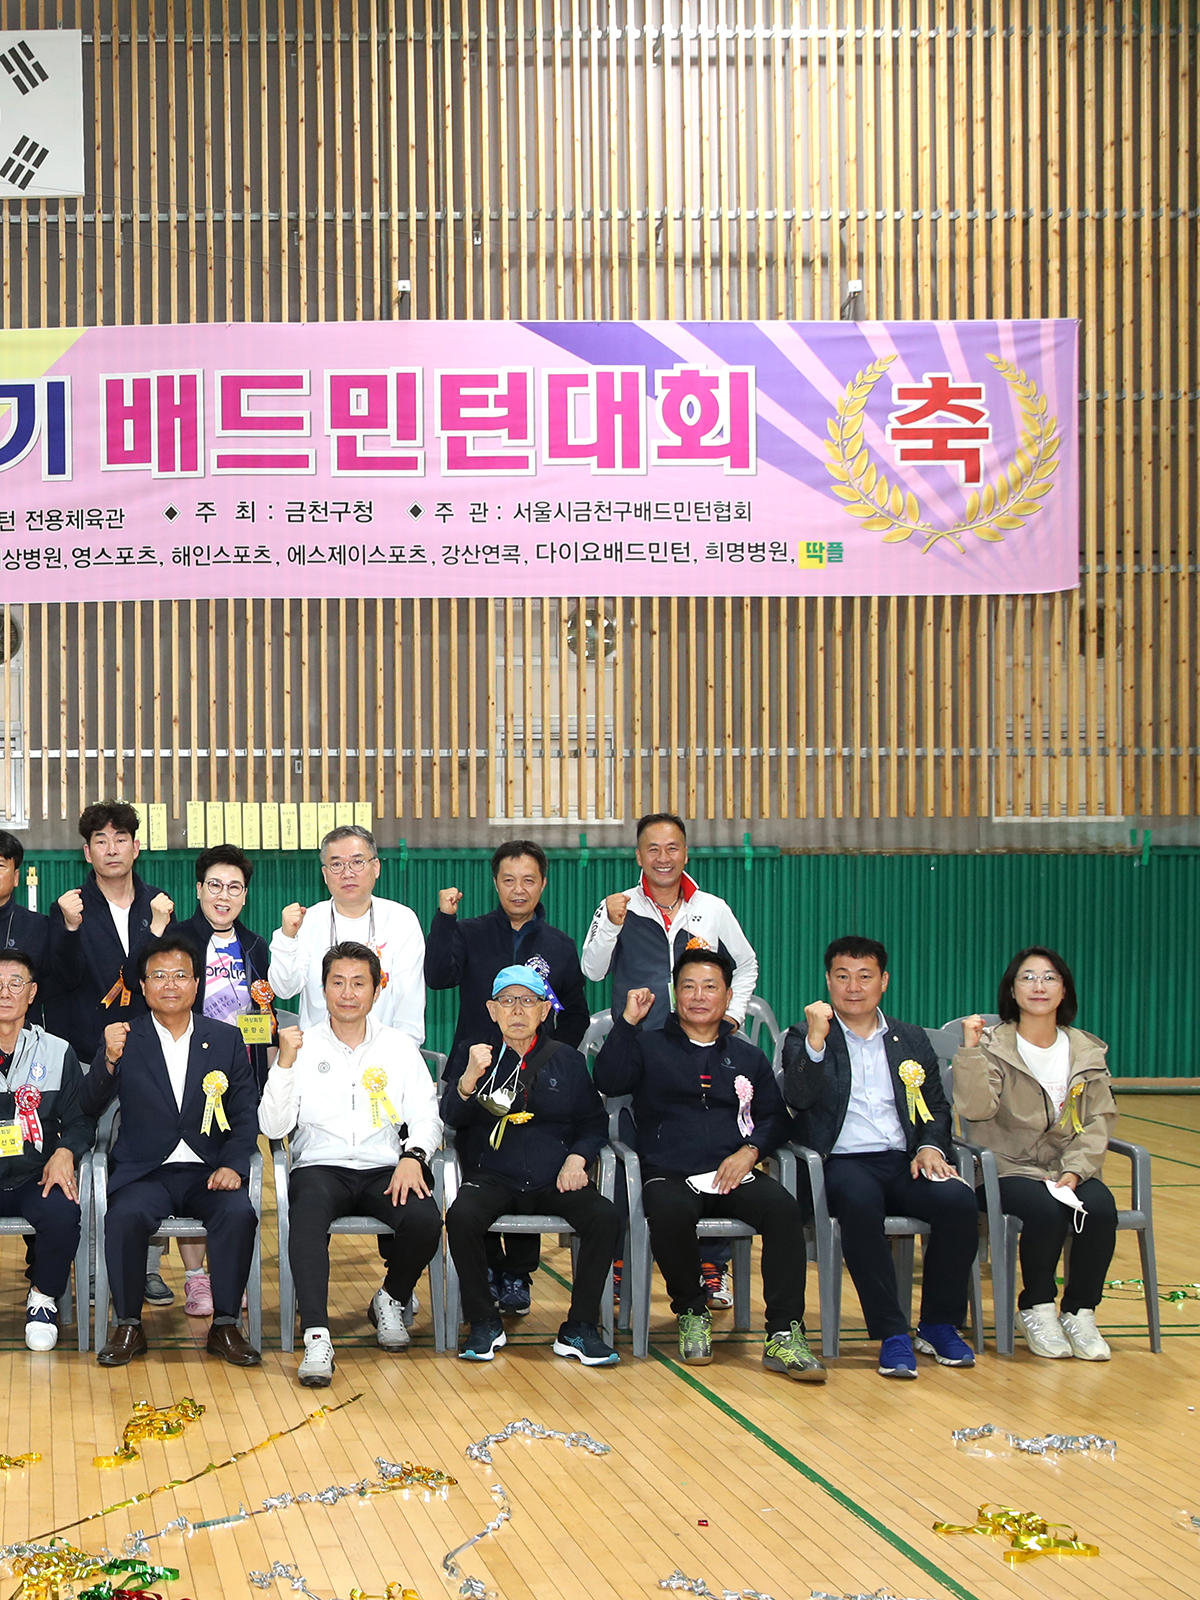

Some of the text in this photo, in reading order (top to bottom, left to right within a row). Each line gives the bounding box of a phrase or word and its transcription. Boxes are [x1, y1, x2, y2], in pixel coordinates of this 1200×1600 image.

[106, 370, 750, 473] 배드민턴대회
[891, 377, 988, 482] 축
[25, 508, 126, 532] 전용체육관
[285, 500, 373, 523] 금천구청
[513, 500, 751, 523] 서울시금천구배드민턴협회
[806, 542, 844, 564] 딱플
